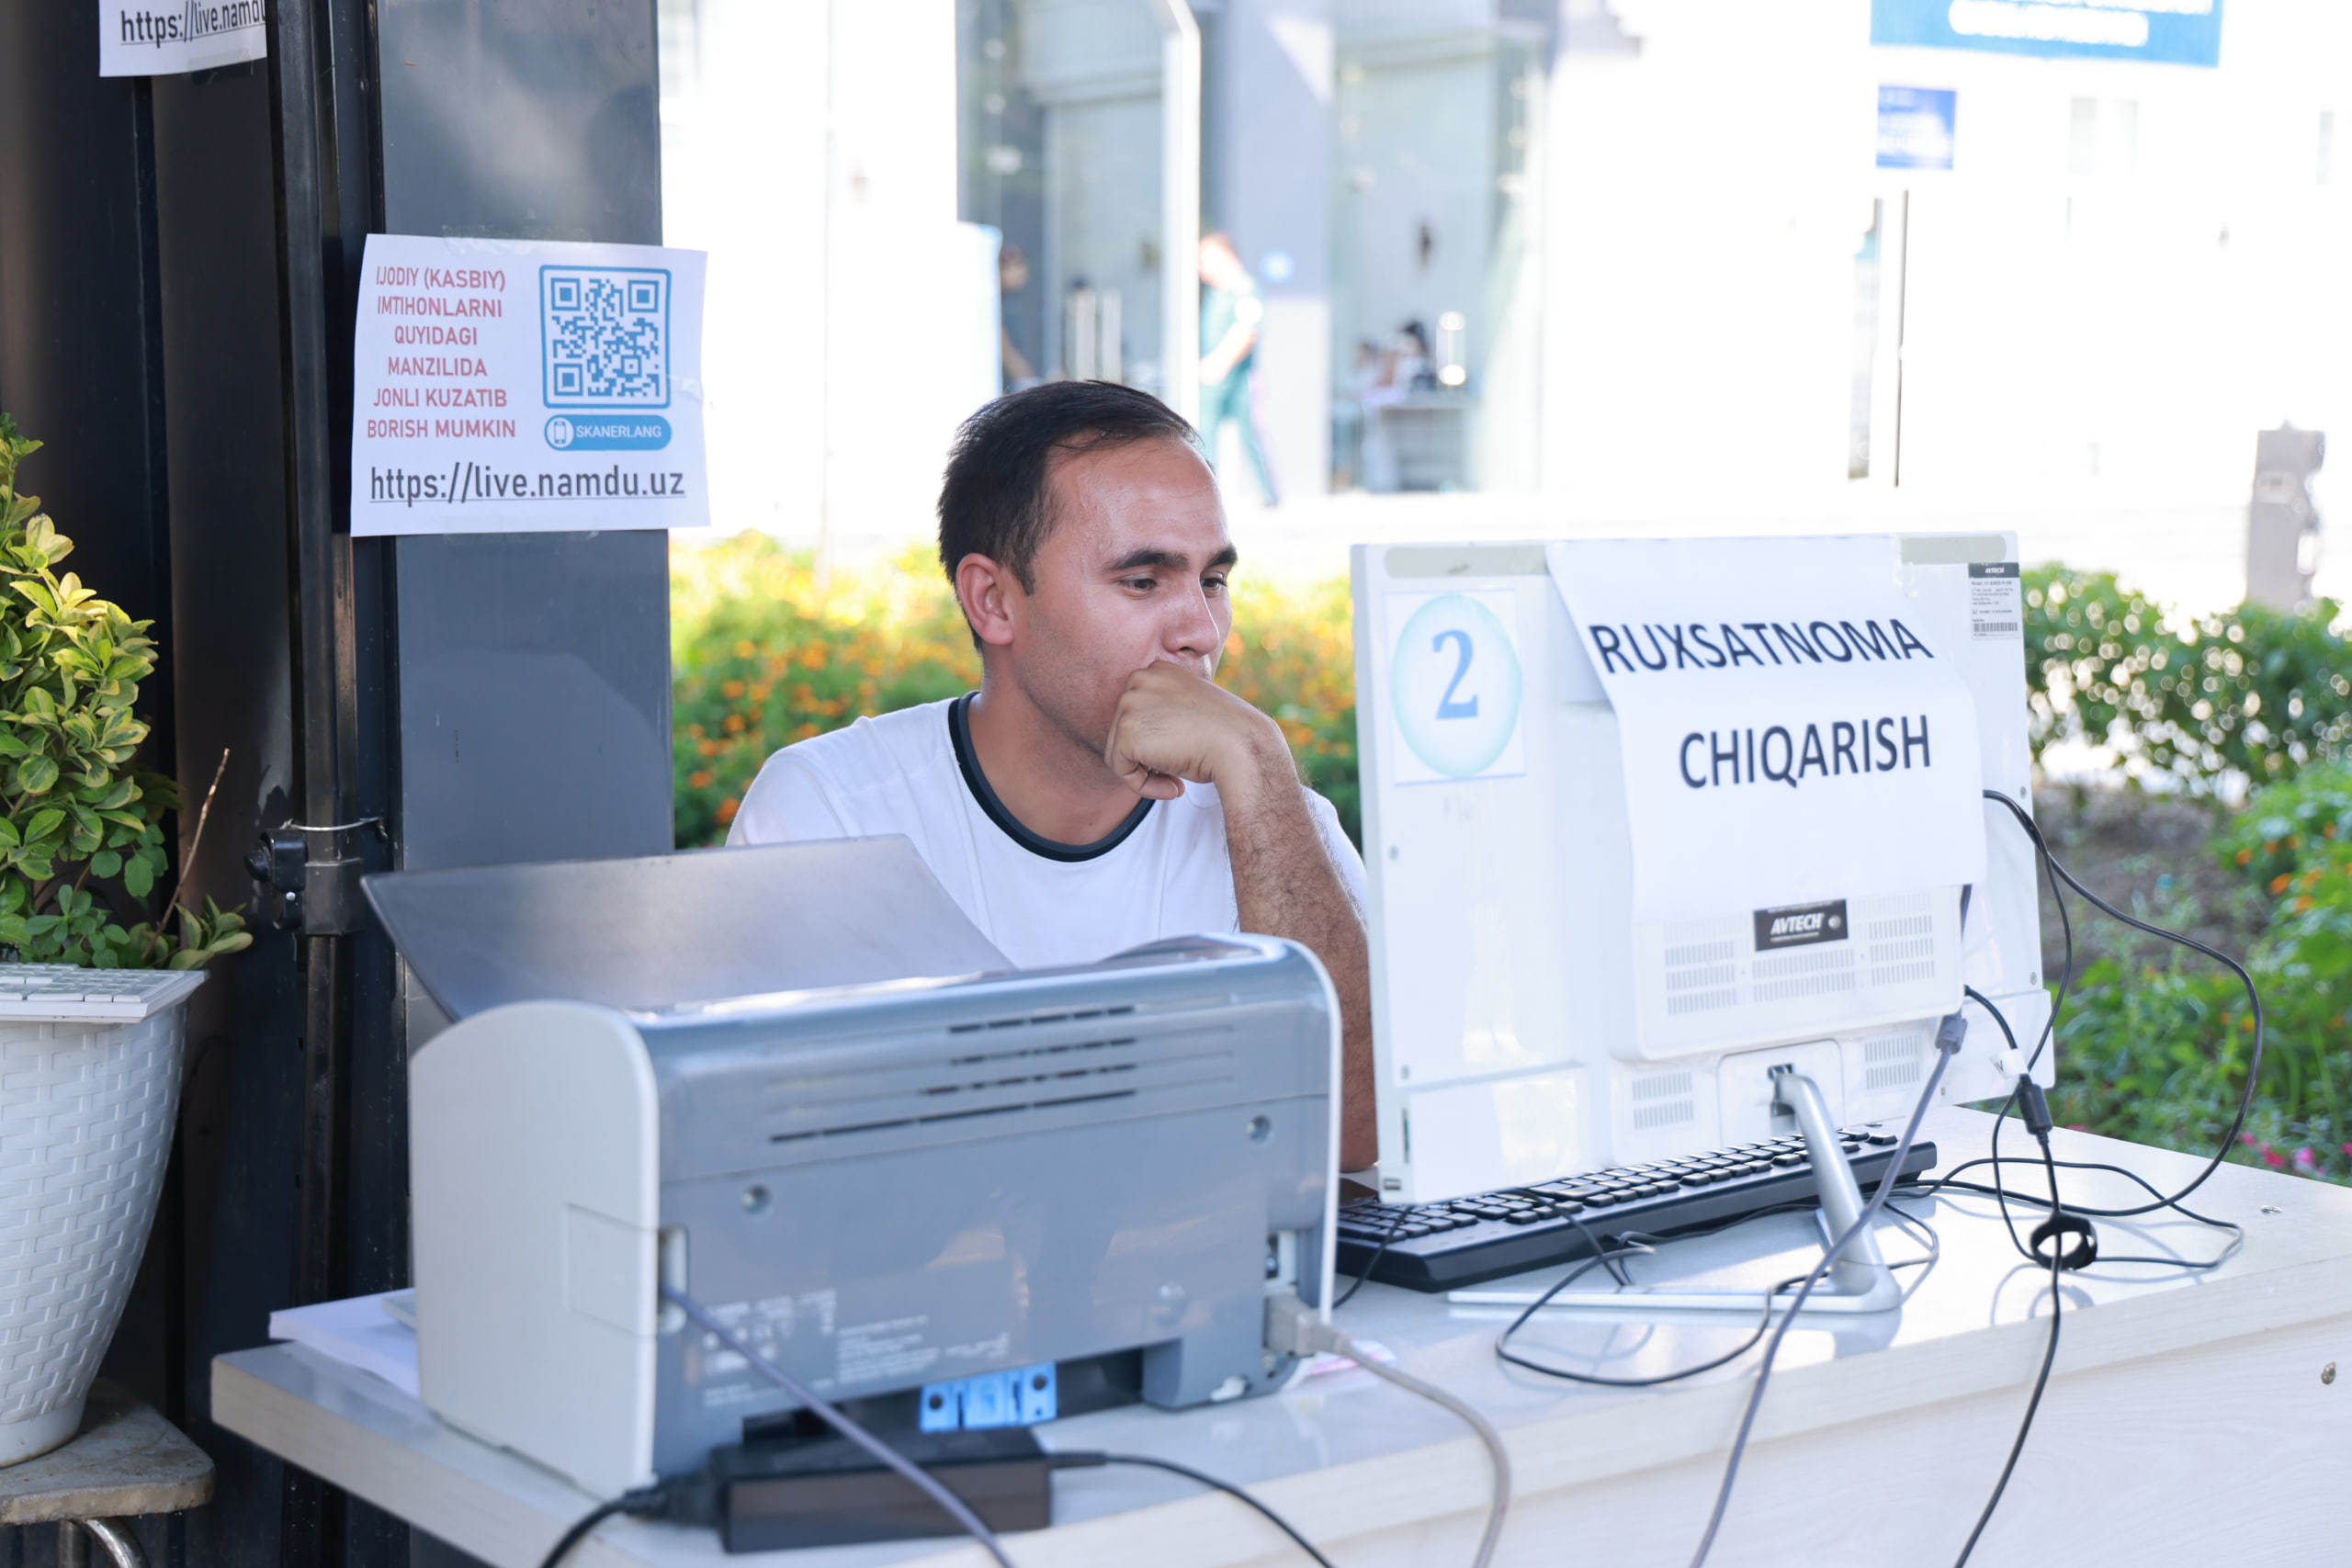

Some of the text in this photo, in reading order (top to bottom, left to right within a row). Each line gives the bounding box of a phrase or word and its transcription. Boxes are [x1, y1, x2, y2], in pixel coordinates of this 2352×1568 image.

[376, 265, 506, 292] IJODIY (KASBIY)
[377, 296, 503, 318] IMTIHONLARNI
[394, 325, 478, 346] QUYIDAGI
[388, 356, 488, 377] MANZILIDA
[373, 388, 508, 407] JONLI KUZATIB
[368, 419, 516, 438] BORISH MUMKIN
[576, 425, 662, 438] SKANERLANG
[370, 462, 686, 507] https://live.namdu.uz
[1589, 618, 1935, 673] RUXSATNOMA
[1430, 628, 1479, 720] 2
[1679, 715, 1931, 789] CHIQARISH
[1770, 912, 1826, 935] AVTECH
